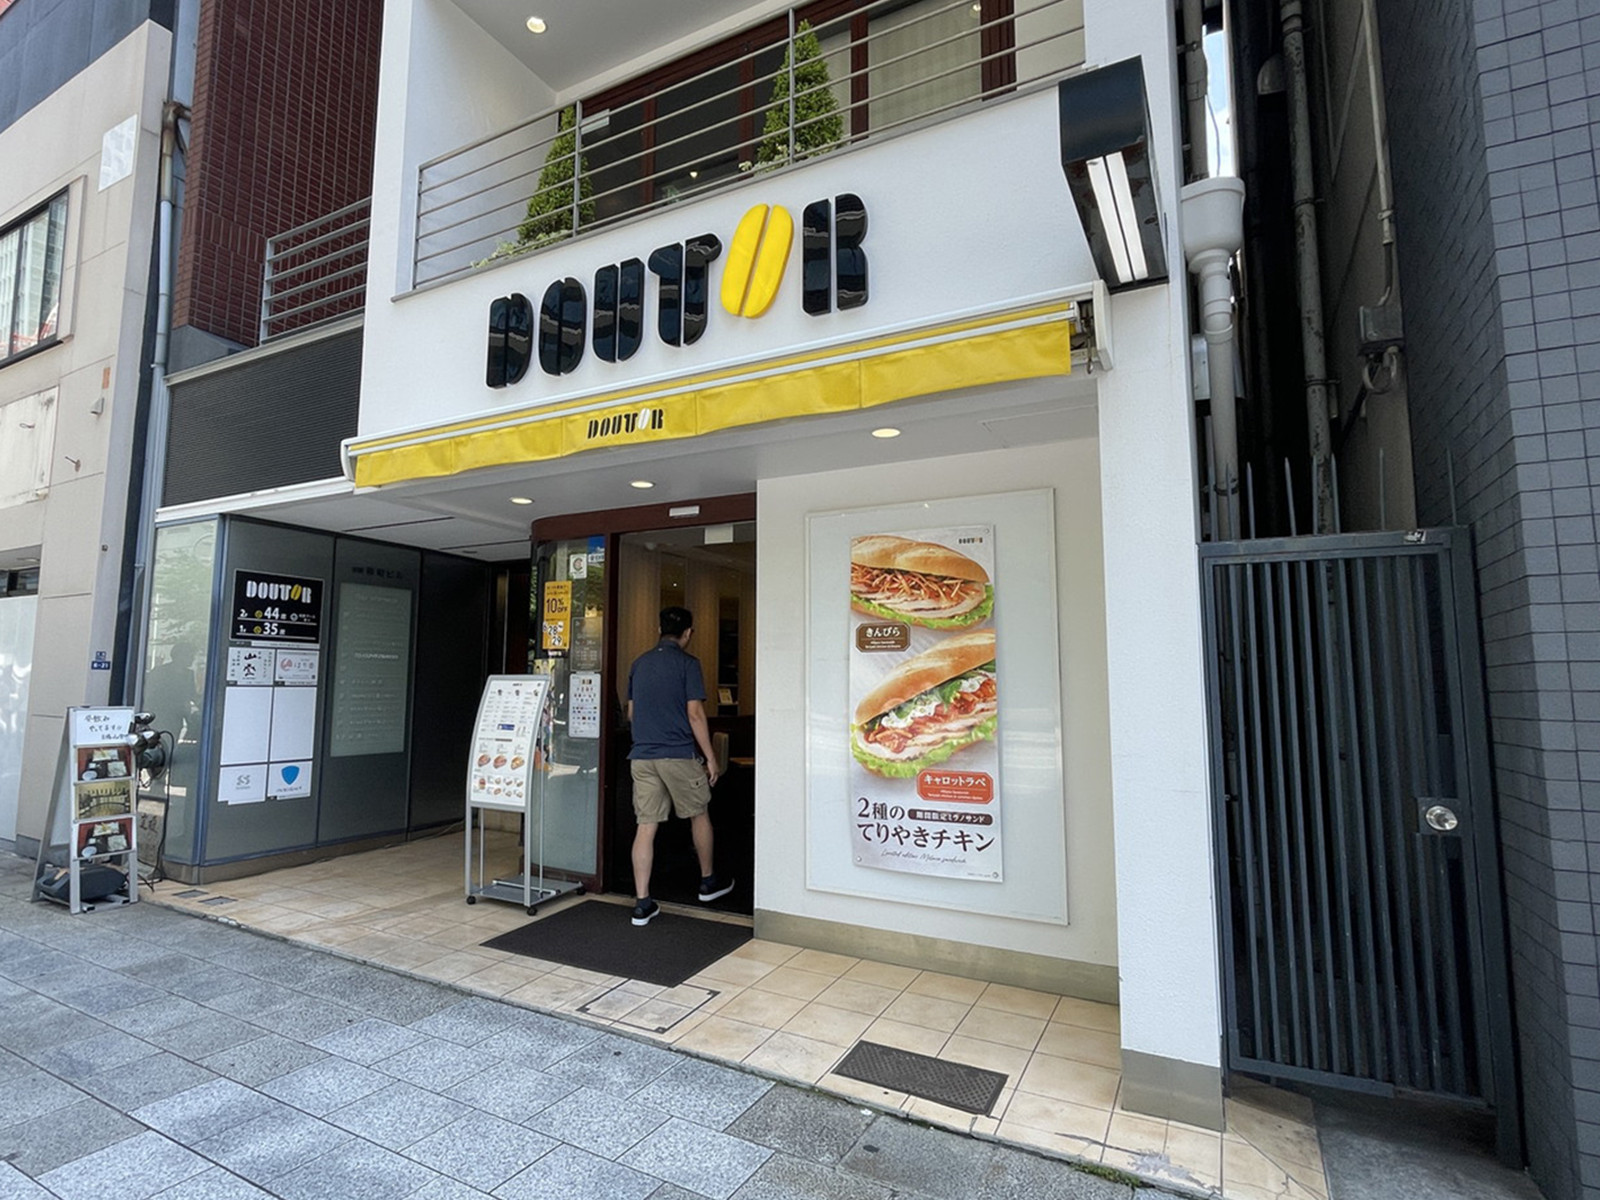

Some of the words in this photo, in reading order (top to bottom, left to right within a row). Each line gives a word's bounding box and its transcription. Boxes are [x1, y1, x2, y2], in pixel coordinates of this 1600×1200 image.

[486, 192, 869, 389] DOUTOR
[587, 408, 664, 439] DOUTOR
[246, 580, 312, 603] DOUTOR
[857, 797, 905, 820] 2種の
[857, 822, 996, 852] てりやきチキン
